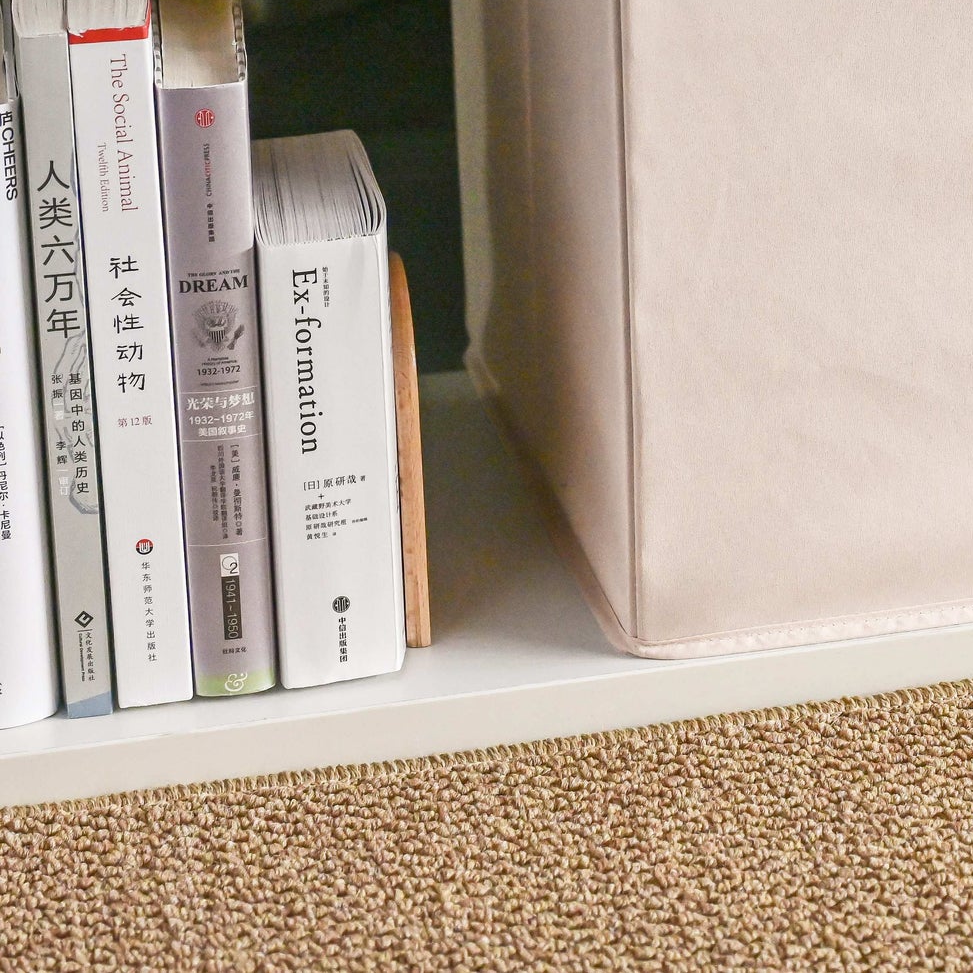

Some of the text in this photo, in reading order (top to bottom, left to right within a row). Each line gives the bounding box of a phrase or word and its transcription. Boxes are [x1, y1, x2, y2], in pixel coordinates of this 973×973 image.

[110, 54, 139, 212] The Social Animal
[97, 142, 111, 213] Twelfth Edition
[37, 159, 81, 339] 人类六万年
[179, 274, 249, 294] DREAM
[108, 255, 147, 394] 社会性动物
[51, 373, 64, 399] 张振
[197, 365, 241, 376] 1932-1972
[292, 267, 324, 455] Ex-formation
[185, 391, 255, 411] 光荣与梦想
[56, 441, 68, 465] 李辉
[68, 372, 90, 494] 基因中的人类历史
[229, 562, 238, 574] 2
[140, 561, 158, 662] 华东师范大学出版社
[338, 616, 348, 663] 中信出版集团
